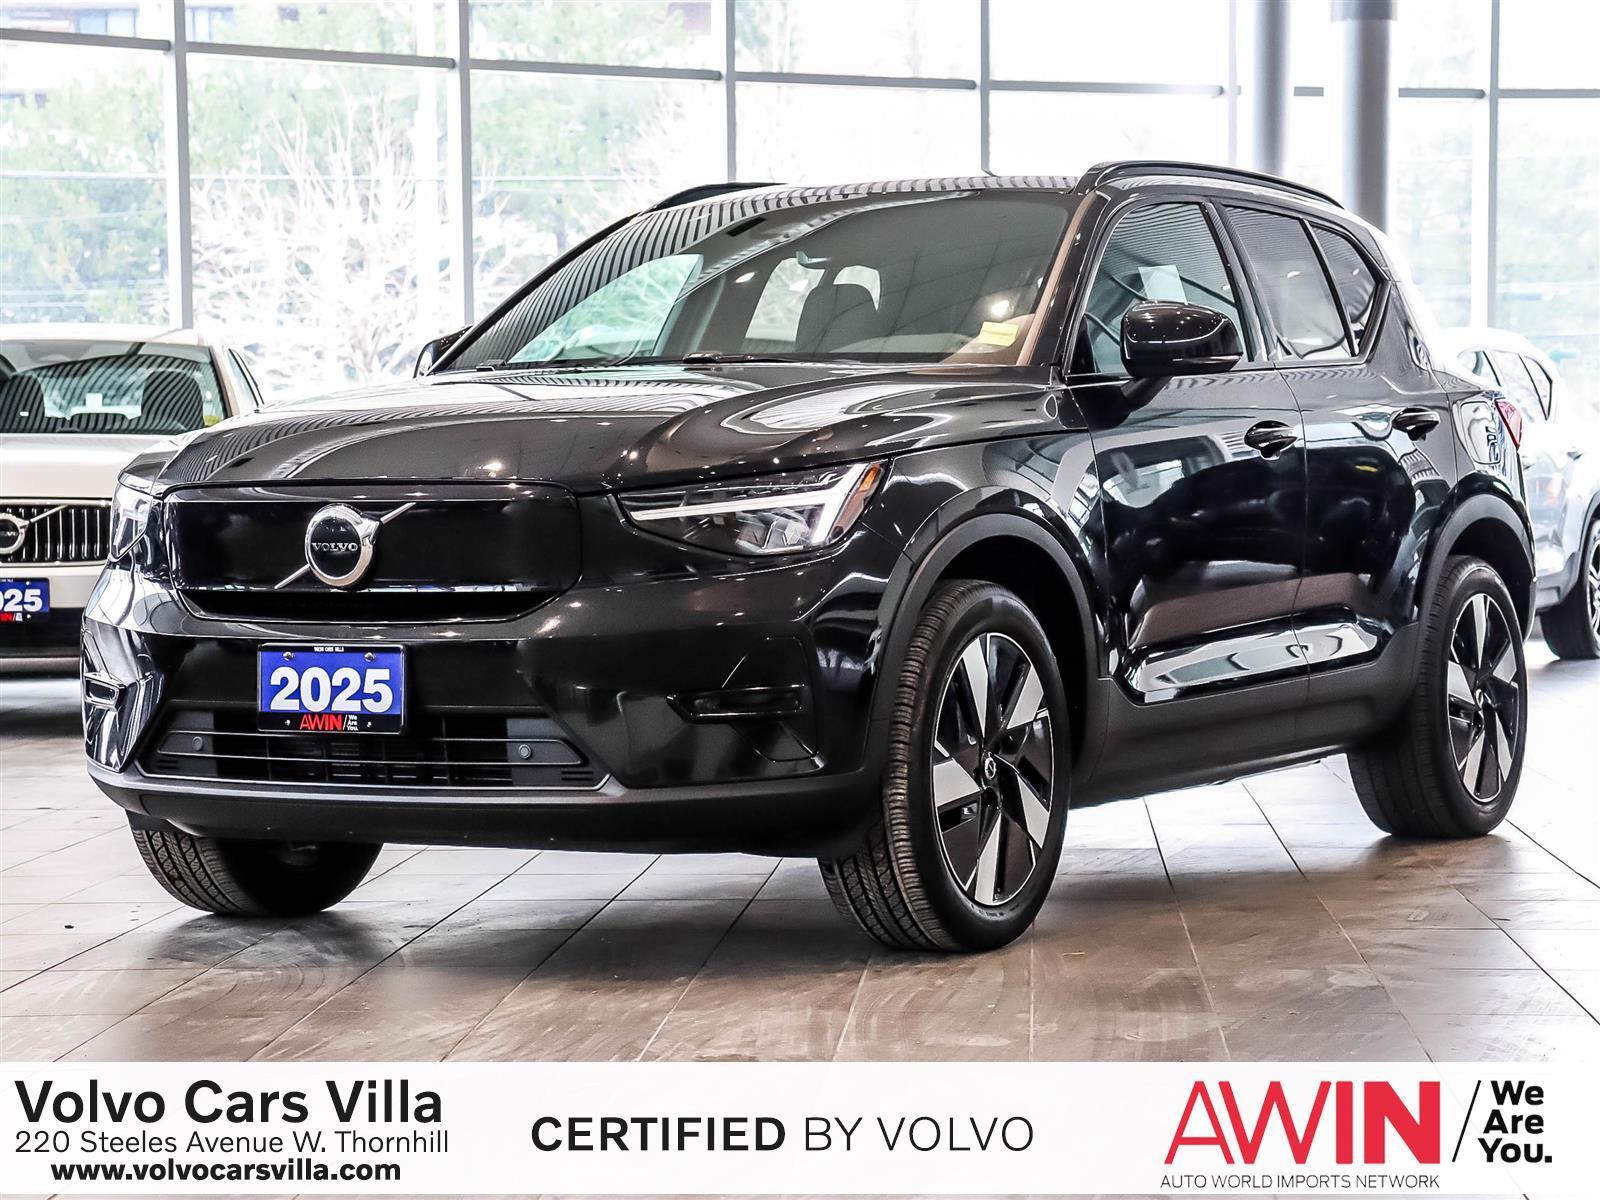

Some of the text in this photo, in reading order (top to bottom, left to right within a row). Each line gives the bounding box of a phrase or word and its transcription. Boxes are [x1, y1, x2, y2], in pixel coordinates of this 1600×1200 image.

[311, 543, 358, 552] VOLVO
[0, 589, 43, 612] 25
[270, 667, 393, 713] 2025
[300, 714, 342, 730] AWIN
